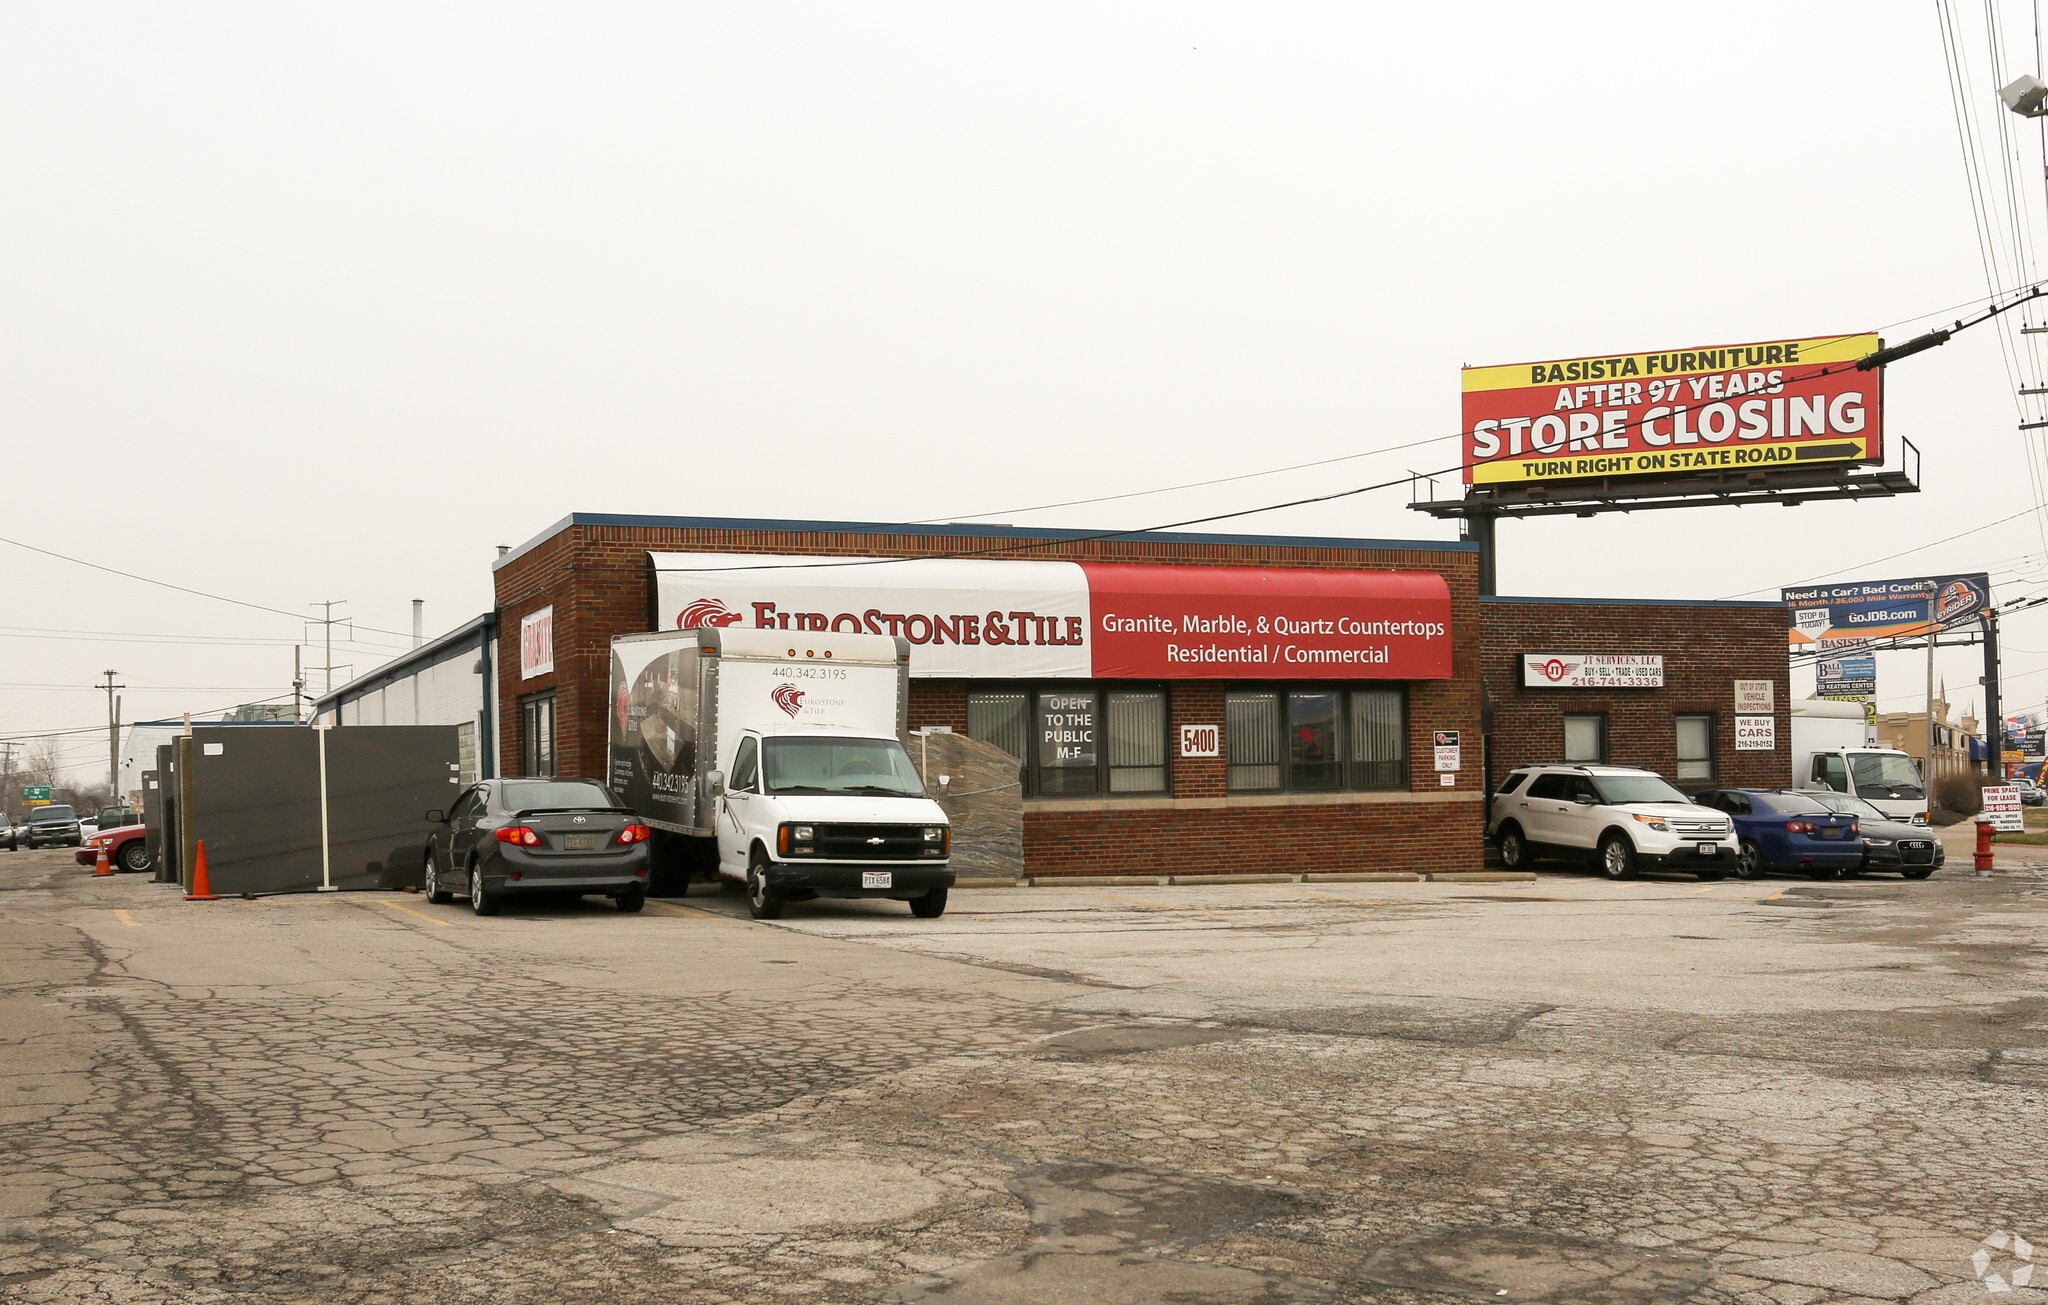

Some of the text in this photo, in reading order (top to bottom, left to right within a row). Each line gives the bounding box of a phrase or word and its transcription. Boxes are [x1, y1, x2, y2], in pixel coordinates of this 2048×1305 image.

[1531, 343, 1800, 384] BASISTA FURNITURE
[1554, 370, 1785, 411] AFTER 97 YEARS
[1472, 391, 1866, 458] STORE CLOSING
[1523, 446, 1793, 477] TURN RIGHT ON STATE ROAD
[1785, 589, 1818, 601] Need
[1820, 590, 1829, 598] a
[1831, 587, 1859, 598] Car?
[1862, 584, 1886, 595] Bad
[1799, 598, 1828, 607] Month
[1866, 594, 1887, 602] Mile
[1888, 592, 1929, 601] Warranty
[1937, 594, 1973, 619] BYRIDER
[1798, 611, 1826, 621] STOP IN
[1848, 610, 1917, 623] GoJDB.com
[1102, 613, 1445, 640] Granite, Marble, & Quartz Countertops
[1801, 620, 1826, 629] TODAY!
[1821, 637, 1869, 649] BASISTA
[1167, 643, 1389, 664] Residential / Commercial
[1583, 655, 1593, 665] JT
[1641, 655, 1657, 665] LLC
[772, 667, 847, 680] 440.342.3195
[1549, 665, 1560, 675] JT
[1584, 667, 1662, 677] BUY SELL TRADE USED CARS
[1819, 663, 1842, 677] BALL
[1571, 677, 1659, 686] 216-741-3336
[1740, 682, 1767, 691] OUT OF STATE
[1743, 692, 1765, 700] VEHICLE
[1050, 697, 1087, 710] OPEN
[1737, 702, 1772, 711] INSPECTIONS
[1045, 714, 1092, 726] TO THE
[1044, 730, 1092, 743] PUBLIC
[1738, 728, 1773, 737] CARS
[1183, 728, 1215, 753] 5400
[1737, 740, 1773, 748] 216-219-0152
[1056, 746, 1082, 759] M-F
